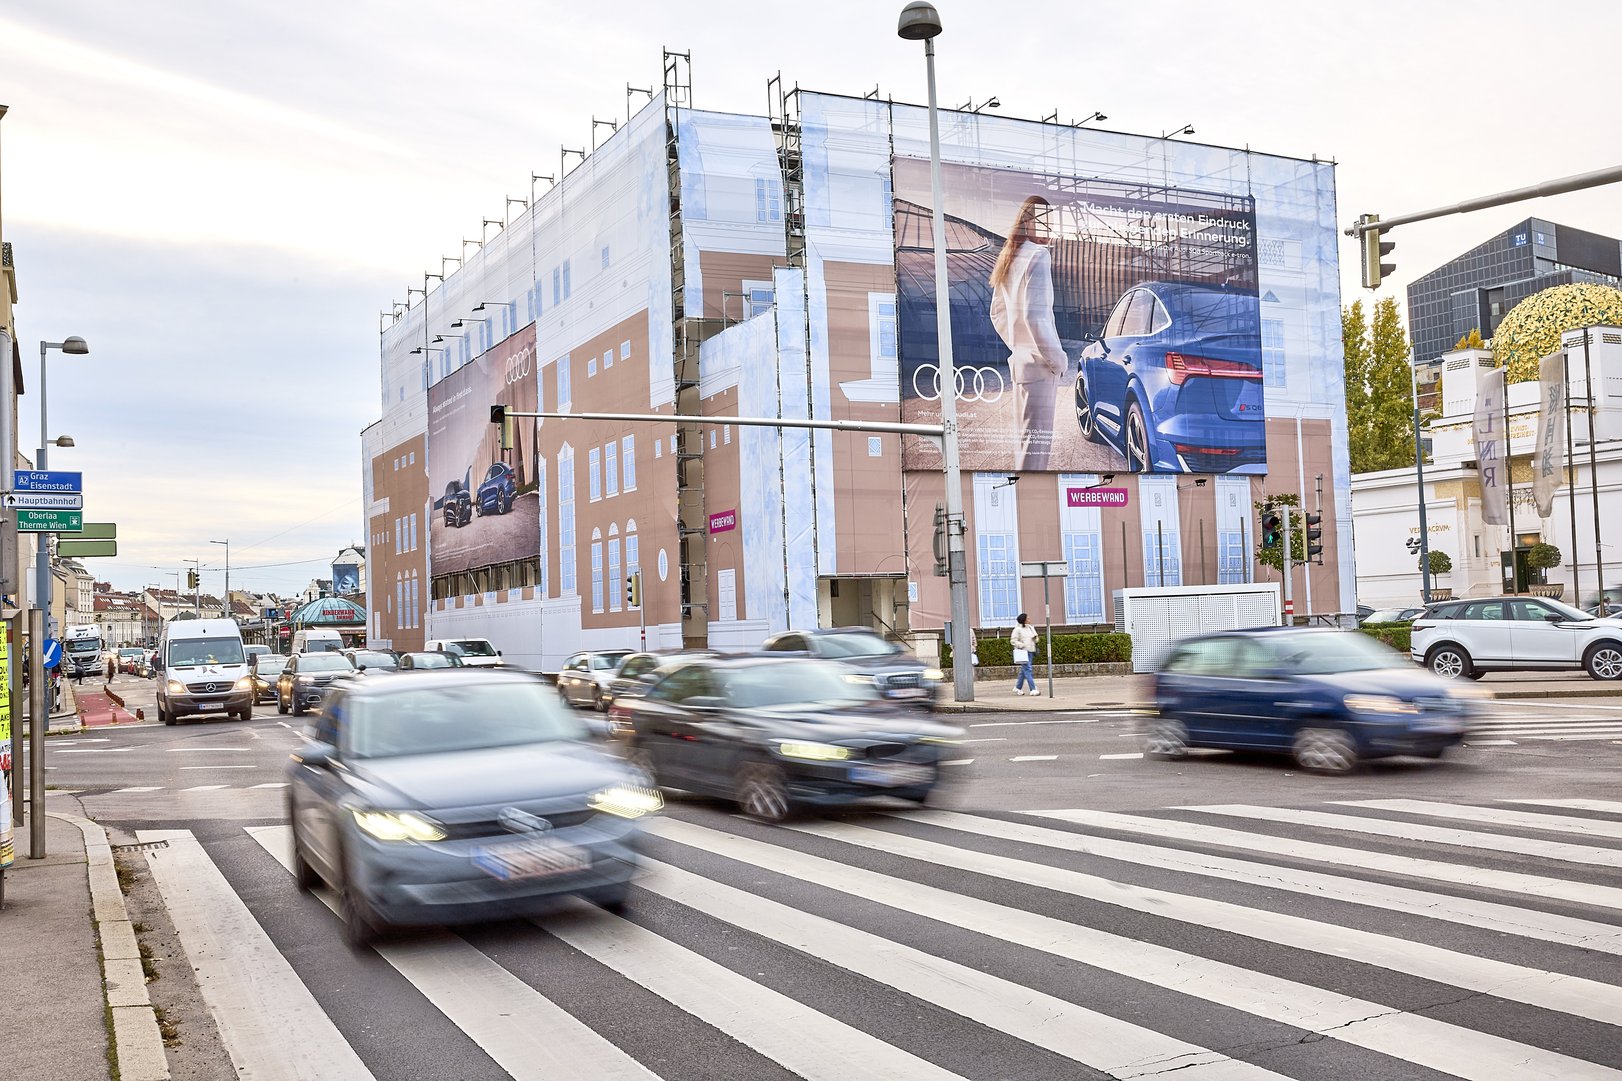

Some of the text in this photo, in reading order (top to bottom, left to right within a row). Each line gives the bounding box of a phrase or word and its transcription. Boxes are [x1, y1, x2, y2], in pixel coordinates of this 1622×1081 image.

[1198, 215, 1250, 230] Eindruck
[1180, 228, 1250, 247] Erinnerung.
[1515, 233, 1526, 241] TU
[19, 475, 28, 485] A2
[30, 472, 49, 480] Graz
[30, 482, 73, 490] Eisenstadt
[18, 496, 77, 506] Hauptbahnhof
[1070, 492, 1125, 503] WERBEWAND
[28, 512, 57, 520] Oberlaa
[19, 521, 67, 530] Therme Wien
